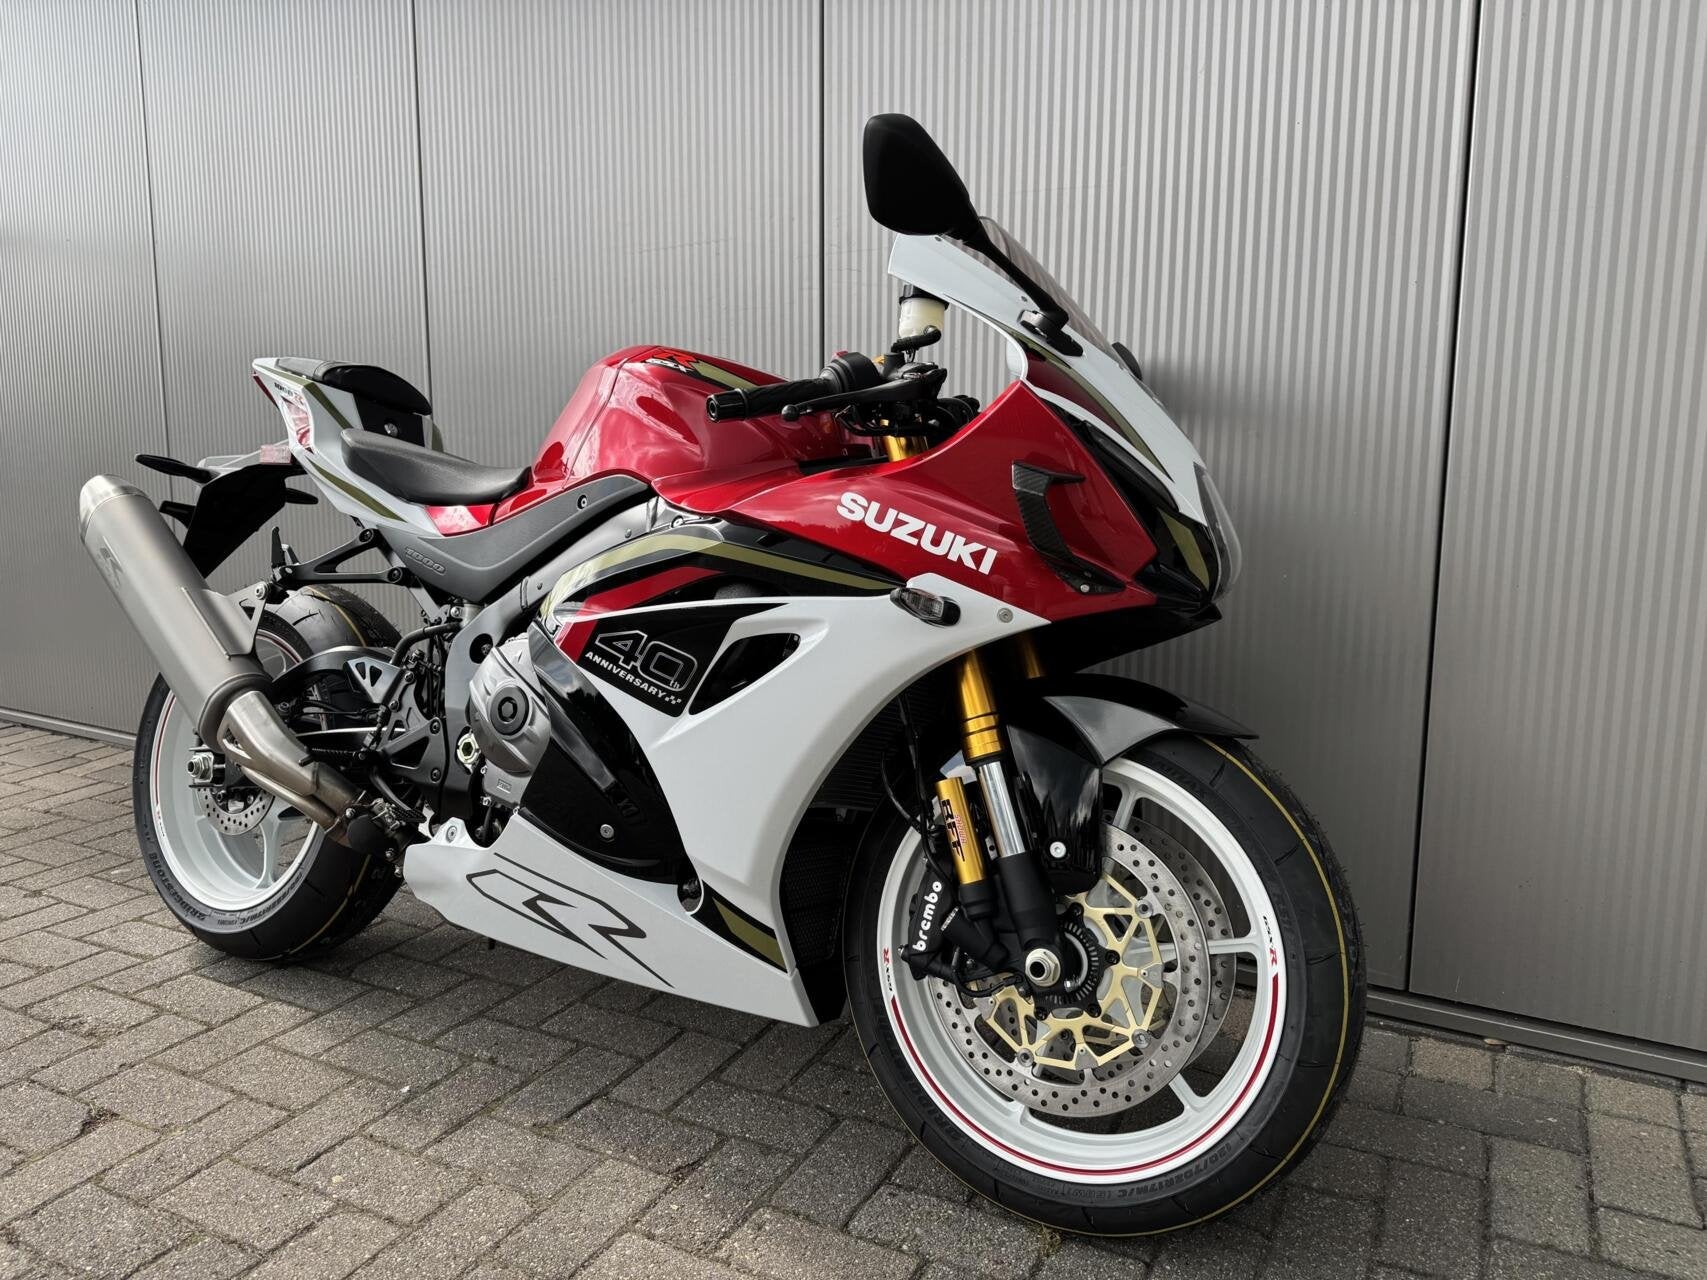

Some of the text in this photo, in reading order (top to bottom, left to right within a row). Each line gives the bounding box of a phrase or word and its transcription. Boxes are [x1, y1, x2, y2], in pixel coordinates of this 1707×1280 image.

[405, 546, 447, 575] 1000
[836, 491, 998, 575] SUZUKI
[585, 651, 667, 698] ANNIVERSARY
[912, 881, 943, 952] brembo
